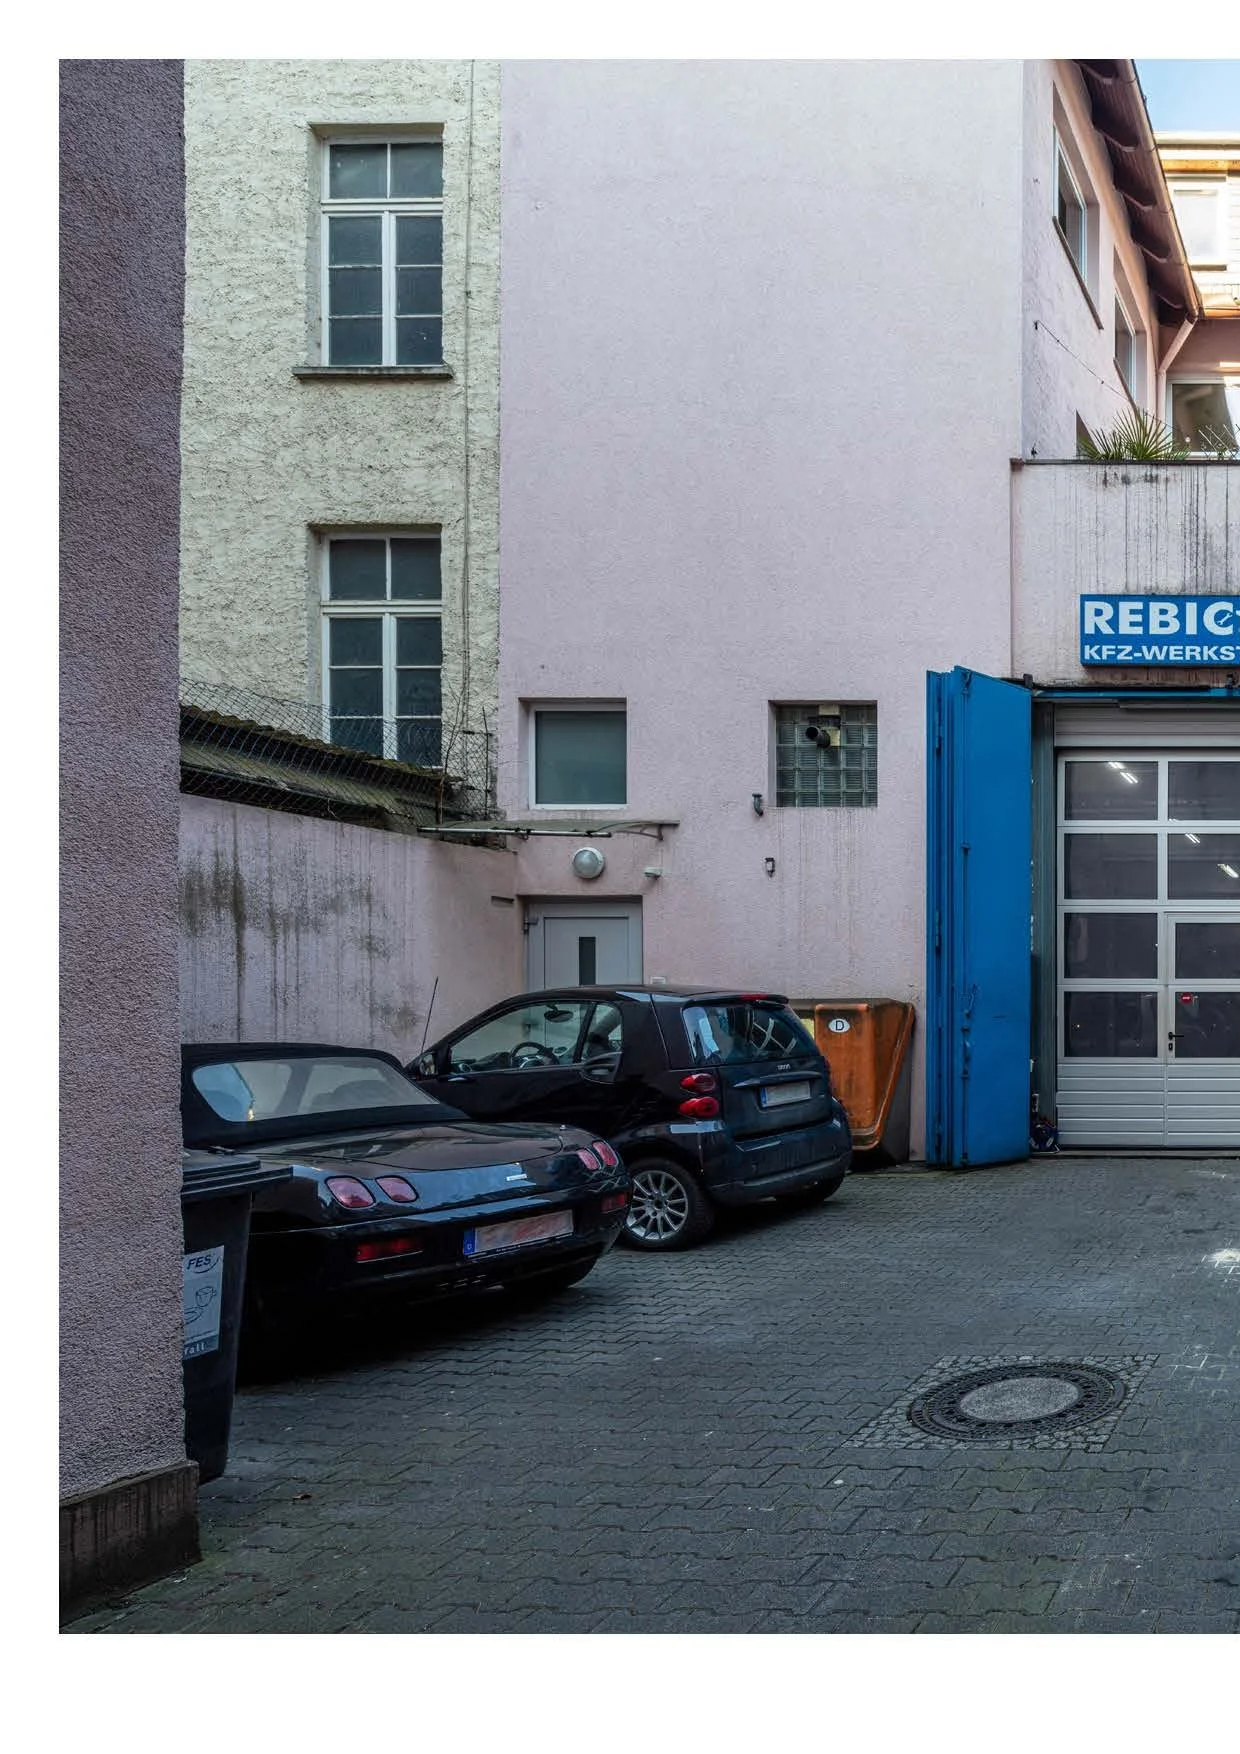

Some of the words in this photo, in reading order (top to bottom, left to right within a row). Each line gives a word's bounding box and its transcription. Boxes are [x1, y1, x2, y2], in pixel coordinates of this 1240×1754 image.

[1084, 601, 1234, 635] REBIC
[835, 1020, 845, 1031] D
[186, 1255, 212, 1270] FES
